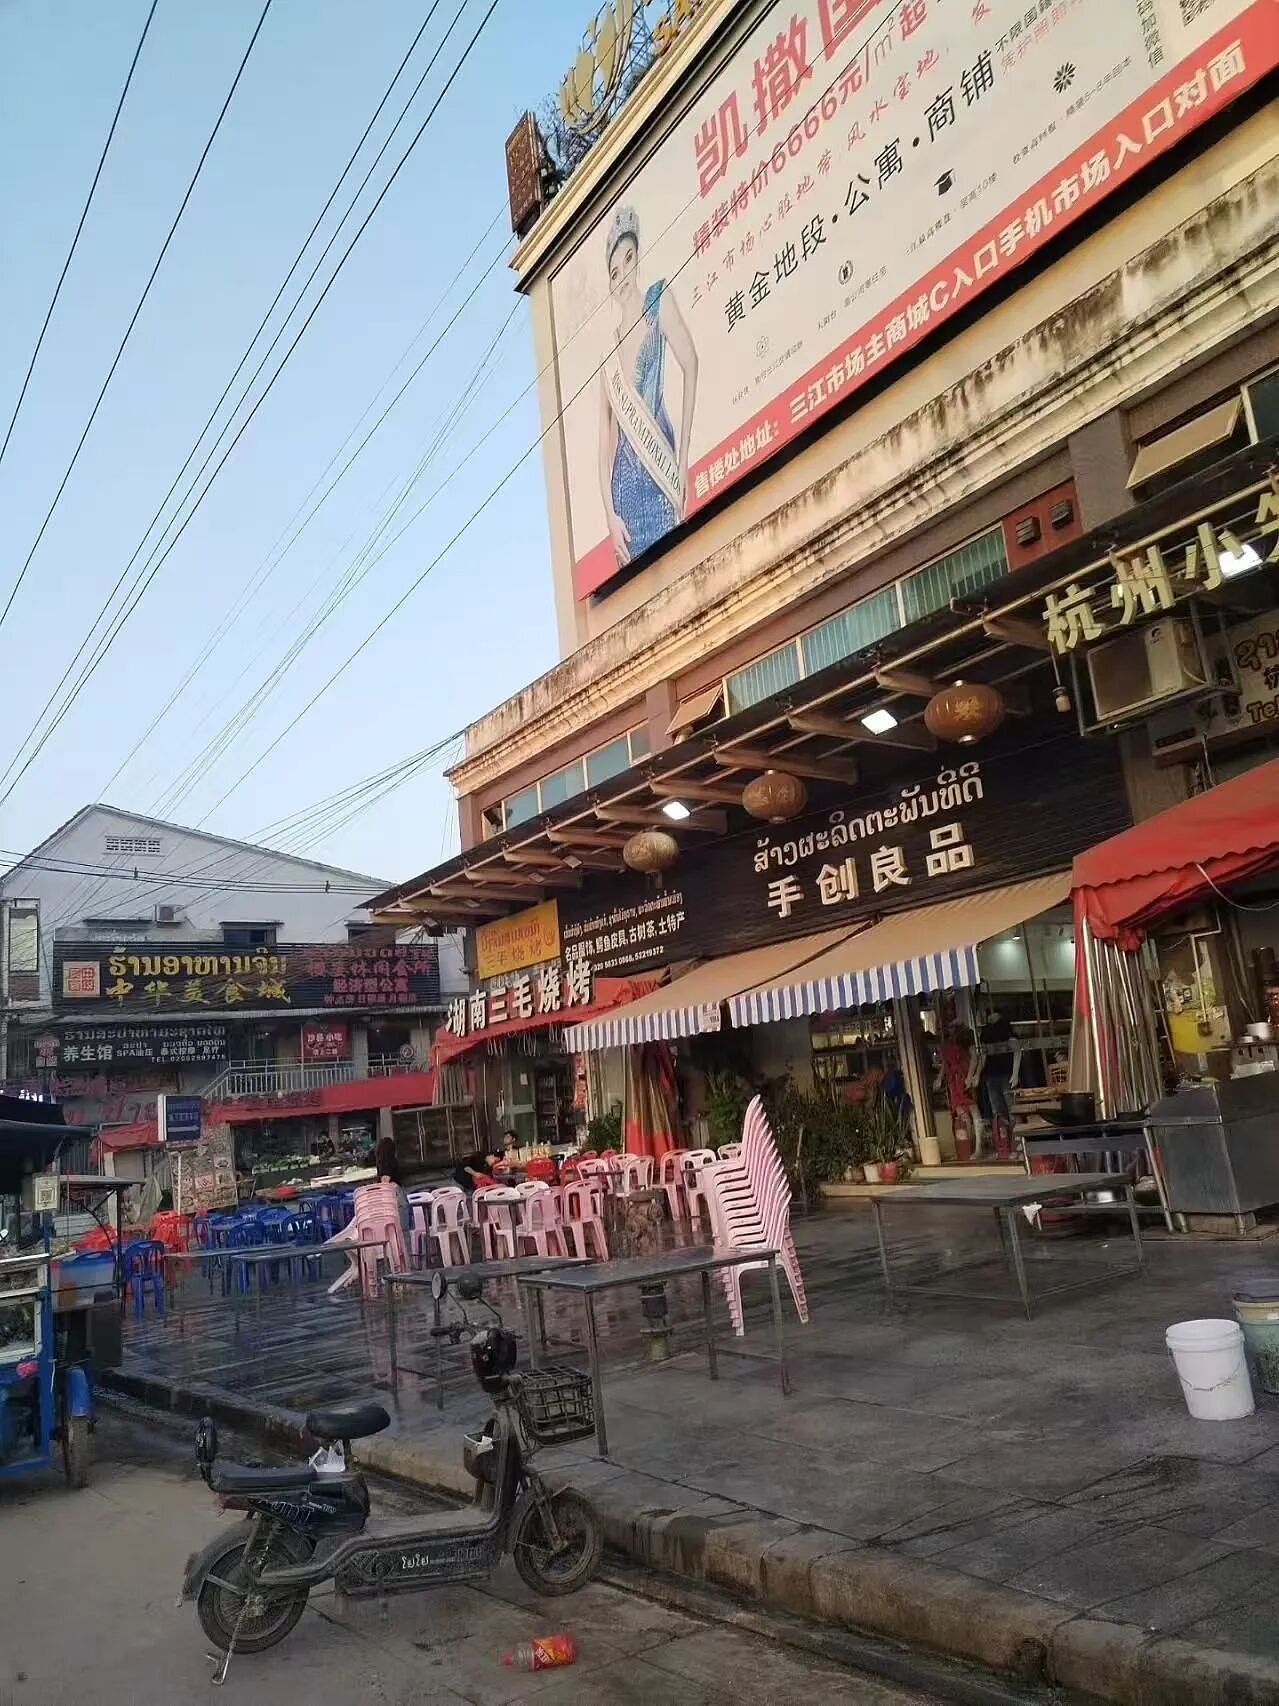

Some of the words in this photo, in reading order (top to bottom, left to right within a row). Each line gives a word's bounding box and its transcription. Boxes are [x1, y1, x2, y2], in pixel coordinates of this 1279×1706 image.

[767, 822, 976, 919] 手创良品
[106, 977, 292, 1008] 中华美食城
[445, 960, 595, 1038] 湖南三毛烧烤
[63, 1045, 113, 1062] 养生馆
